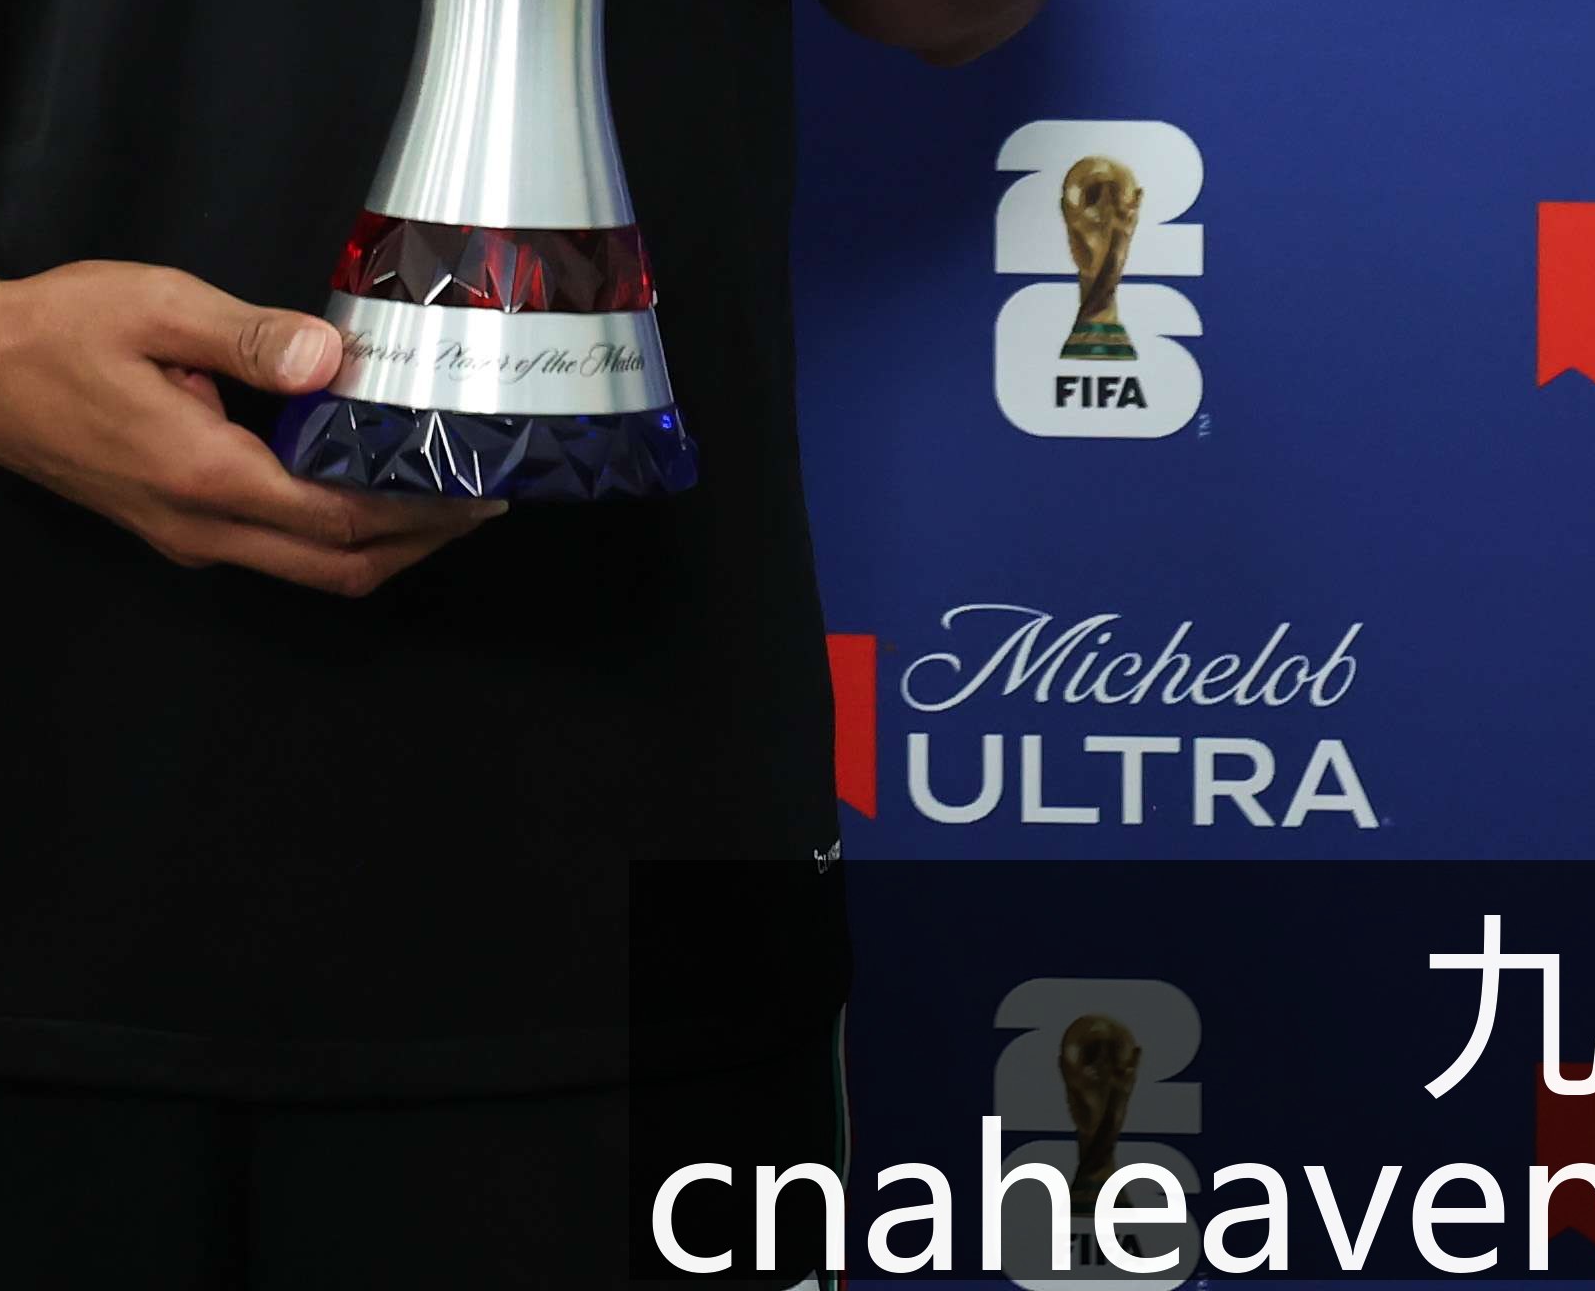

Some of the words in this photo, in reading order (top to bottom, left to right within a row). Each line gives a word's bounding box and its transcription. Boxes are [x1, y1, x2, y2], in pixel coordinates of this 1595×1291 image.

[542, 347, 577, 374] the
[1056, 376, 1146, 408] FIFA
[901, 604, 1363, 711] Michelob
[908, 733, 1379, 828] ULTRA
